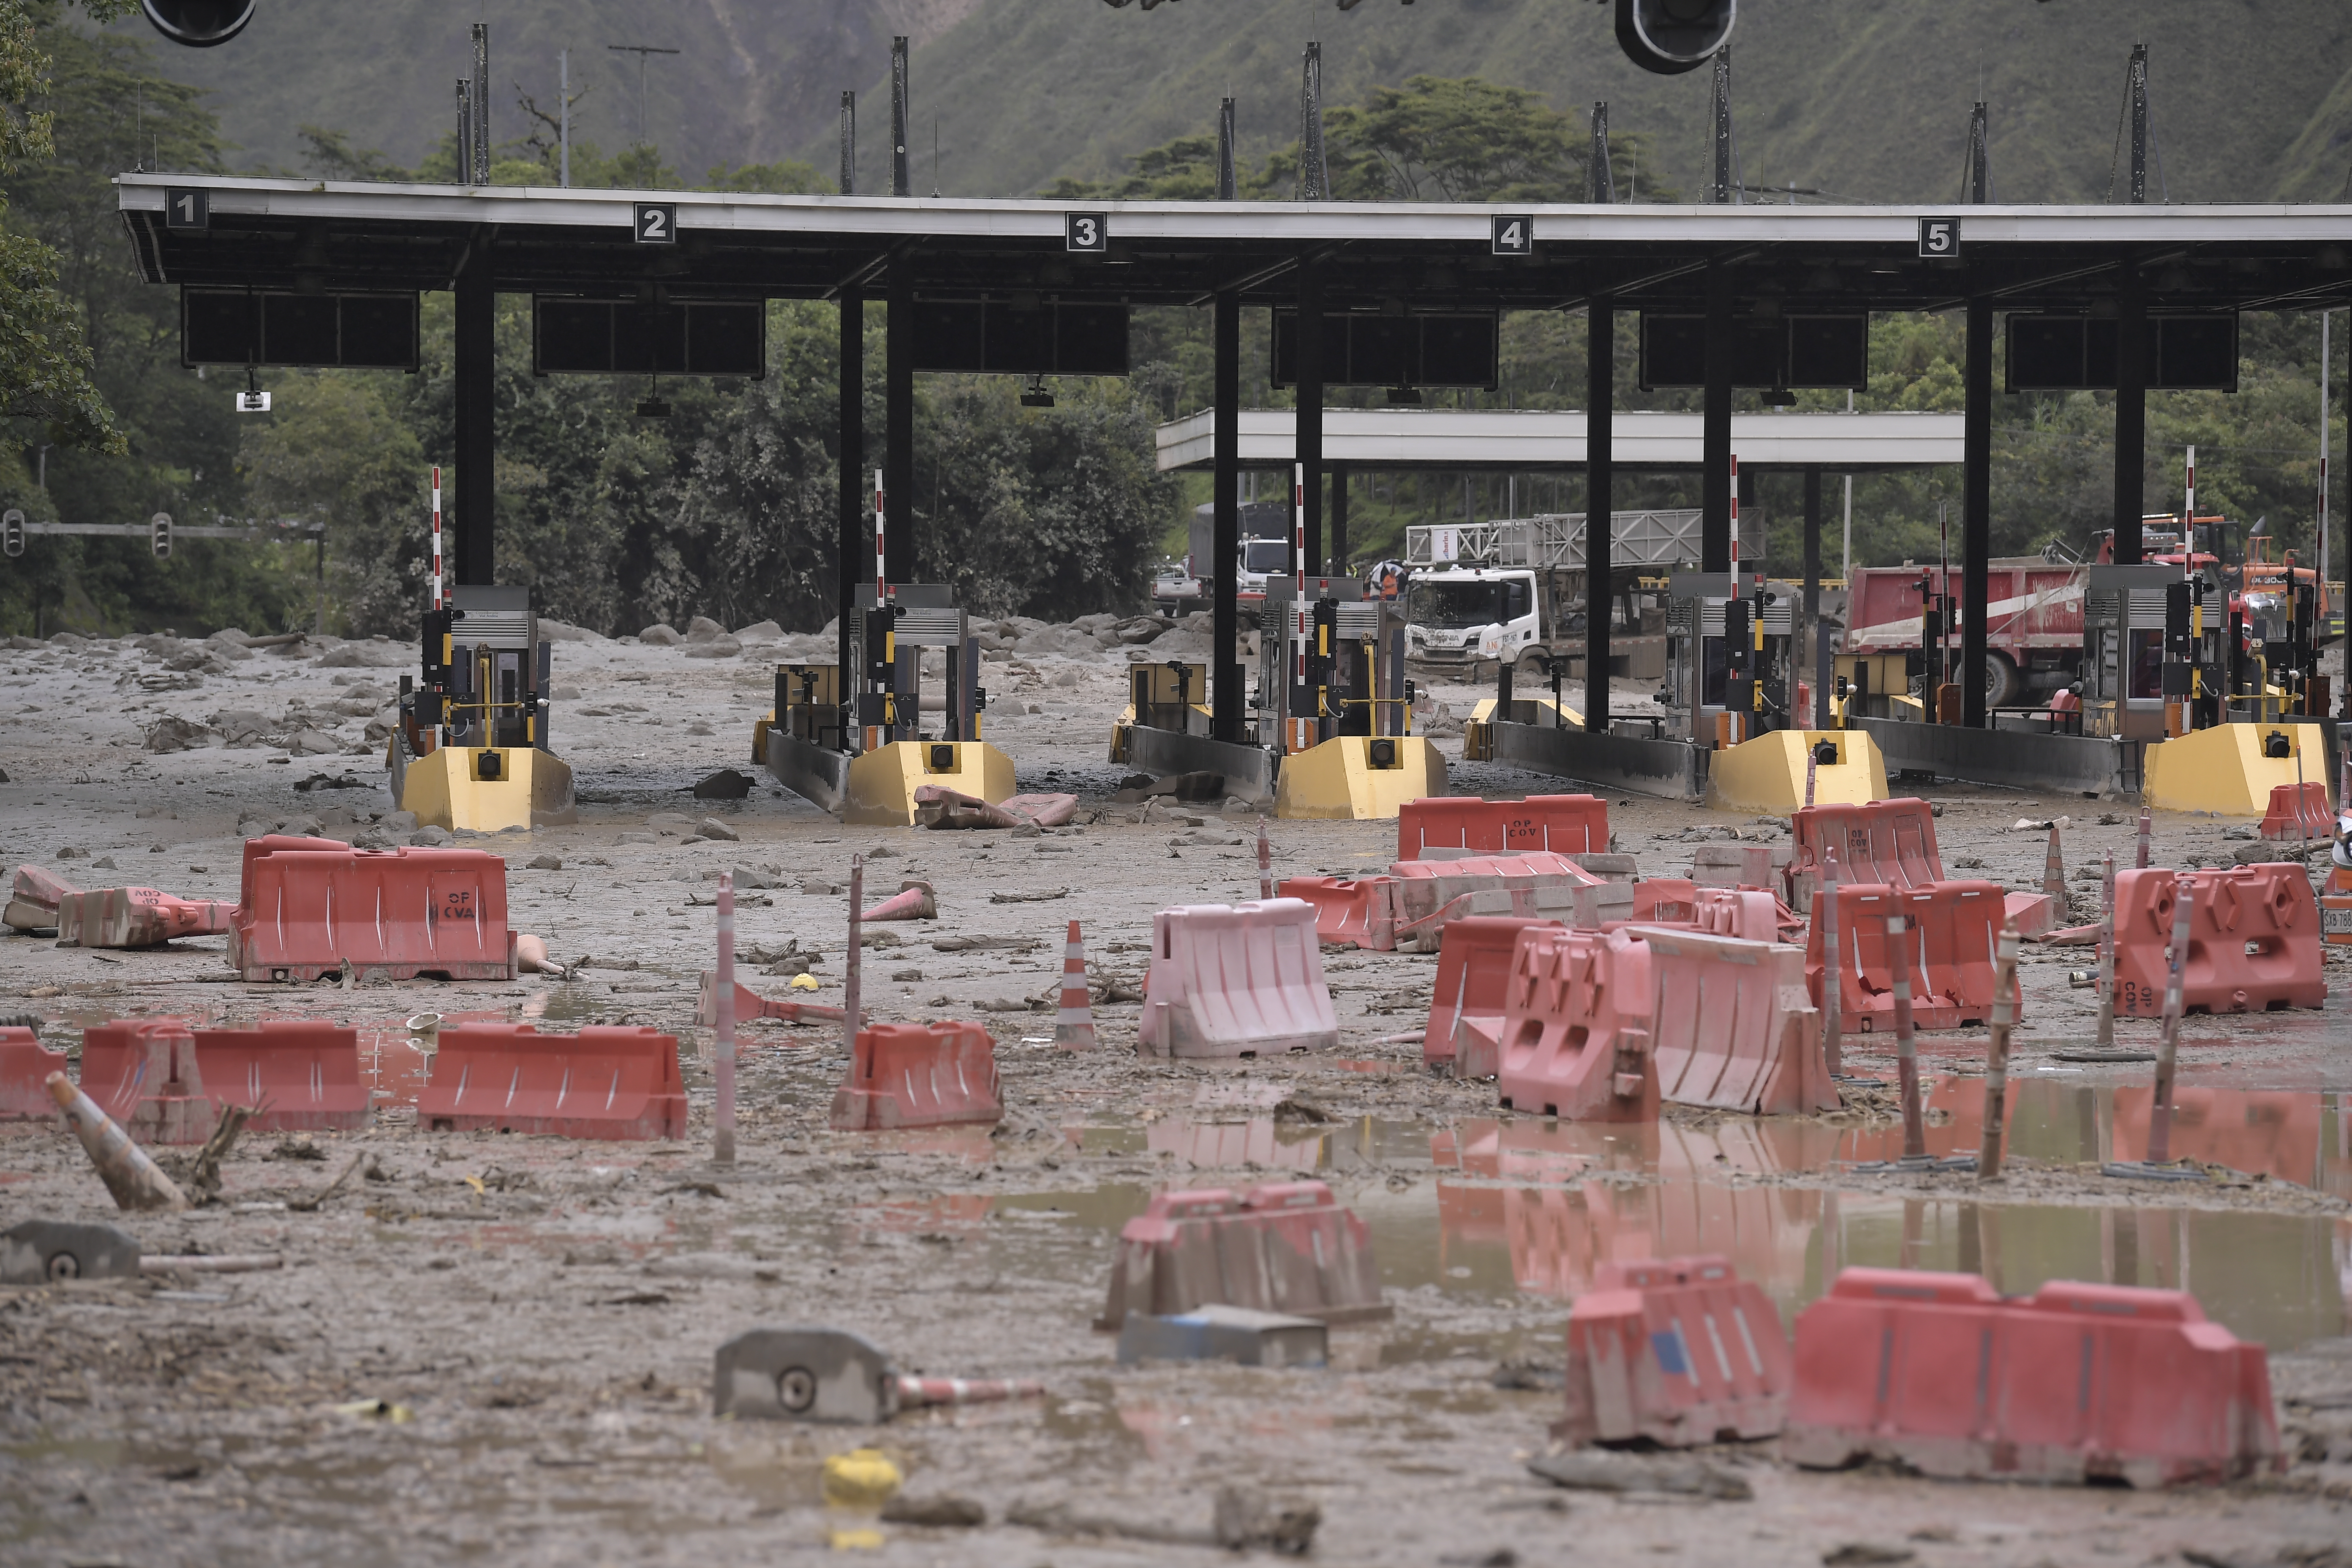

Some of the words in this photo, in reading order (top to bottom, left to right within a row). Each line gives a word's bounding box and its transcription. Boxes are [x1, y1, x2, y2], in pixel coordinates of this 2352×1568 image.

[177, 195, 193, 222] 1
[643, 210, 666, 237] 2
[1075, 218, 1097, 245] 3
[1500, 221, 1524, 248] 4
[1927, 224, 1950, 251] 5
[1509, 828, 1536, 837] COV
[1851, 839, 1866, 847] COV
[1852, 830, 1862, 838] OP
[449, 892, 469, 904] OP
[444, 907, 474, 918] CVA
[2125, 981, 2137, 1013] COV
[2140, 987, 2152, 1007] OP
